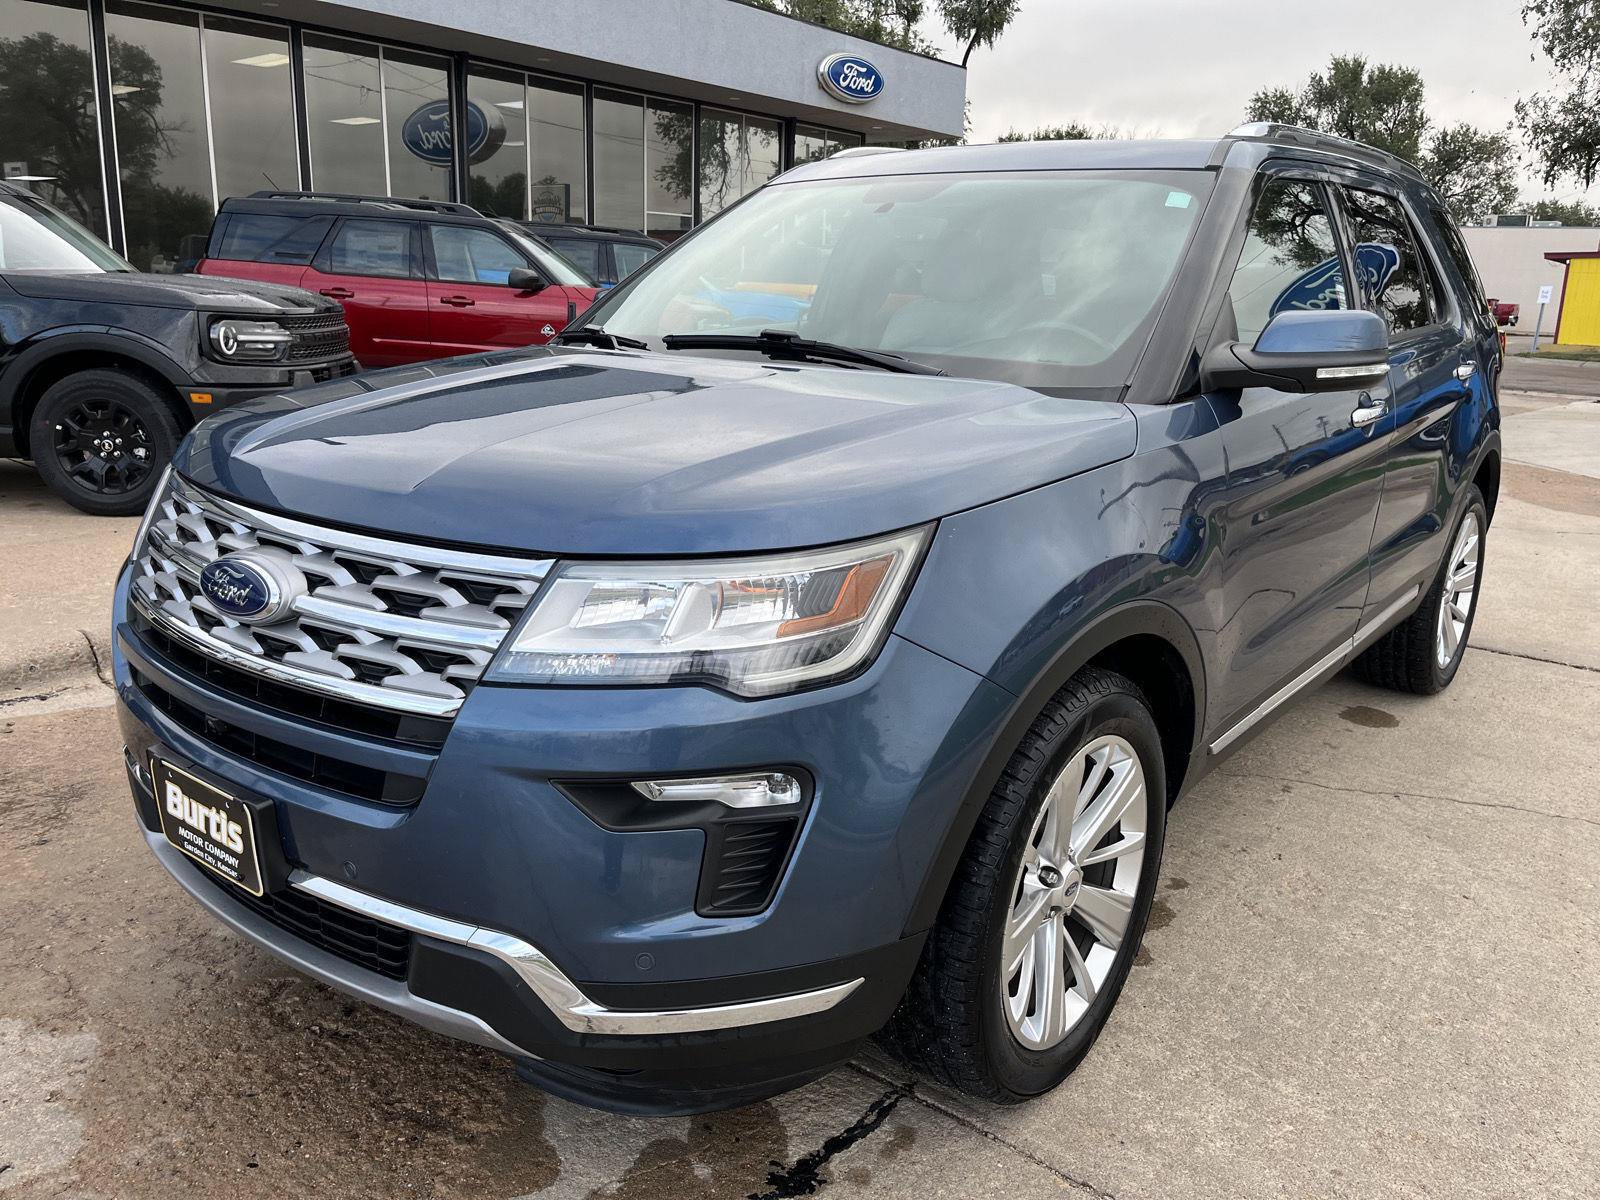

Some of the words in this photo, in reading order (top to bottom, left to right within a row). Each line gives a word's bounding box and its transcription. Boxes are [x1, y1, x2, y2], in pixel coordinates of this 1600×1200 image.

[840, 62, 876, 93] Ford
[208, 566, 253, 606] Ford
[165, 780, 244, 854] Burtis
[178, 826, 204, 848] MOTOR
[204, 841, 240, 869] COMPANY
[184, 841, 205, 859] Garden
[204, 852, 217, 867] City,
[217, 860, 238, 878] Kansas
